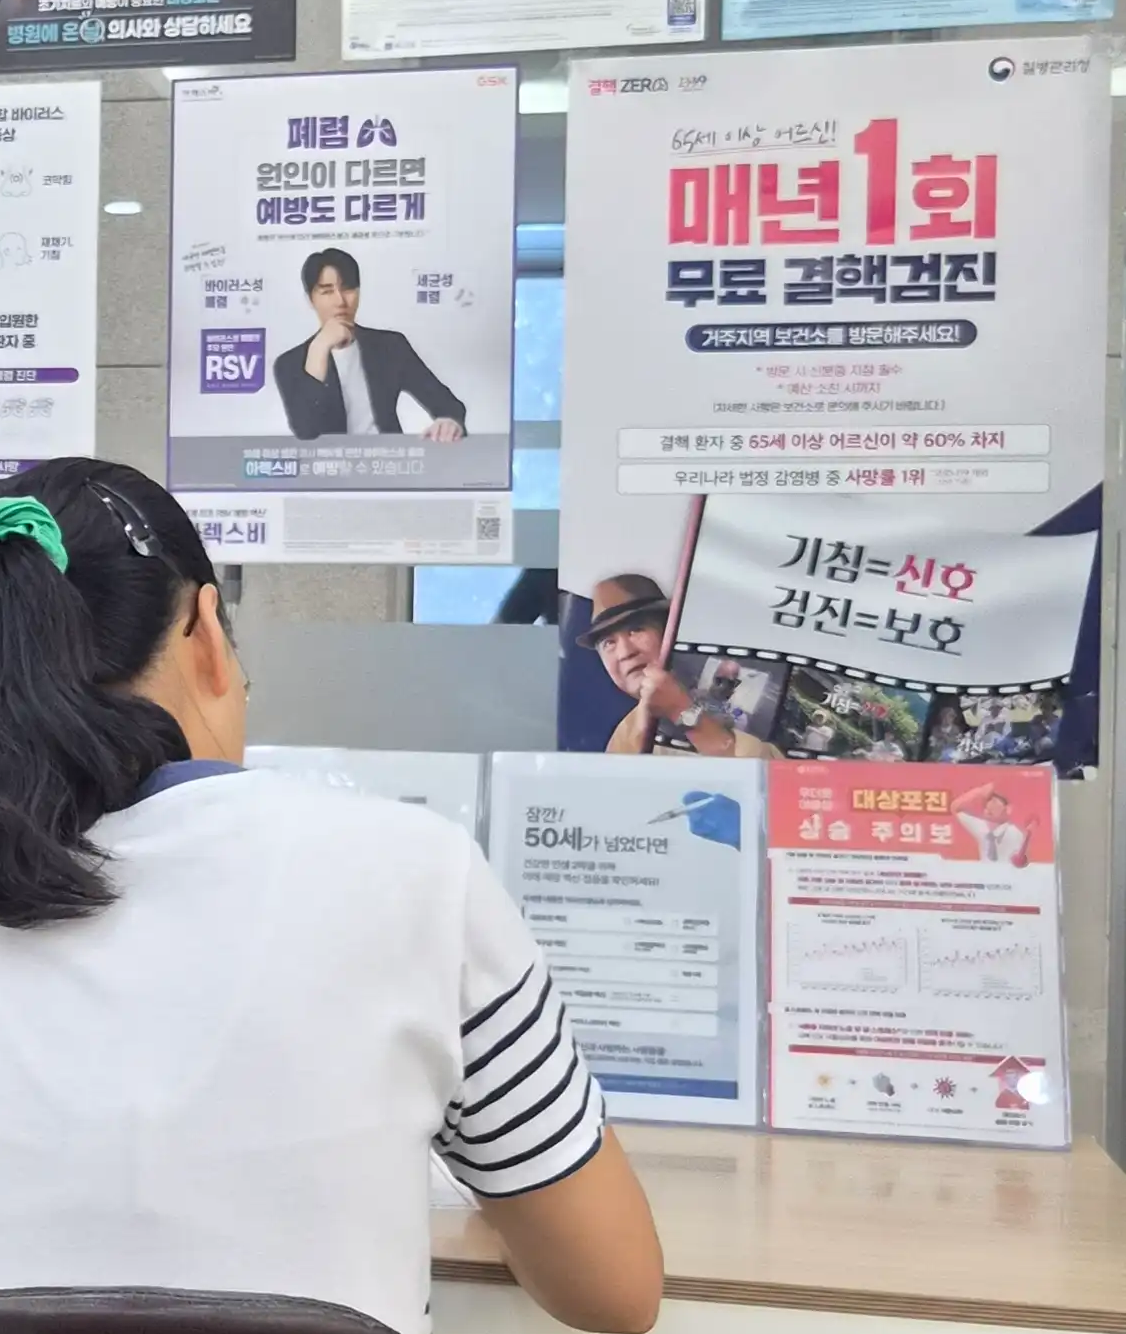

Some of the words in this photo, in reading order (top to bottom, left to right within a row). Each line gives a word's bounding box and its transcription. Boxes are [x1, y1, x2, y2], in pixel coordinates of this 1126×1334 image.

[8, 22, 59, 44] 병원에
[62, 22, 79, 41] 온
[107, 17, 161, 39] 의사와
[163, 13, 253, 37] 상담하세요
[477, 76, 507, 87] GSK
[588, 78, 617, 96] 결핵
[11, 107, 64, 121] 바이러스
[287, 115, 349, 149] 폐렴
[671, 128, 716, 153] 65세
[725, 124, 767, 147] 이상
[774, 120, 837, 145] 어르신!
[256, 160, 336, 191] 원인이
[345, 157, 426, 187] 다르면
[256, 195, 335, 225] 예방도
[344, 192, 425, 222] 다르게
[668, 160, 840, 246] 매년
[205, 278, 263, 292] 바이러스성
[417, 273, 453, 288] 세균성
[665, 259, 767, 308] 무료
[784, 251, 997, 306] 결핵검진
[0, 314, 39, 328] 입원한
[22, 334, 36, 349] 중
[701, 328, 770, 348] 거주지역
[774, 327, 844, 345] 보건소를
[849, 325, 960, 345] 방문해주세요!
[206, 355, 258, 380] RSV
[766, 365, 790, 377] 방문
[796, 365, 806, 377] 시
[817, 383, 840, 395] 소진
[660, 435, 689, 451] 결핵
[695, 435, 724, 451] 환자
[730, 435, 744, 450] 중
[749, 434, 785, 450] 65세
[791, 434, 823, 450] 이상
[829, 432, 897, 450] 어르신이
[902, 432, 917, 449] 약
[924, 432, 966, 448] 60%
[971, 431, 1005, 449] 차지
[674, 470, 734, 486] 우리나라
[739, 470, 768, 486] 법정
[774, 470, 820, 486] 감염병
[826, 470, 841, 486] 중
[845, 469, 896, 486] 사망률
[901, 468, 925, 485] 1위
[778, 534, 977, 602] 기침=신호
[769, 586, 965, 656] 검진=보호
[853, 789, 949, 813] 대상포진
[526, 807, 565, 823] 잠깐!
[524, 826, 599, 851] 50세가
[604, 836, 668, 854] 넘었다면
[871, 821, 954, 844] 주의보
